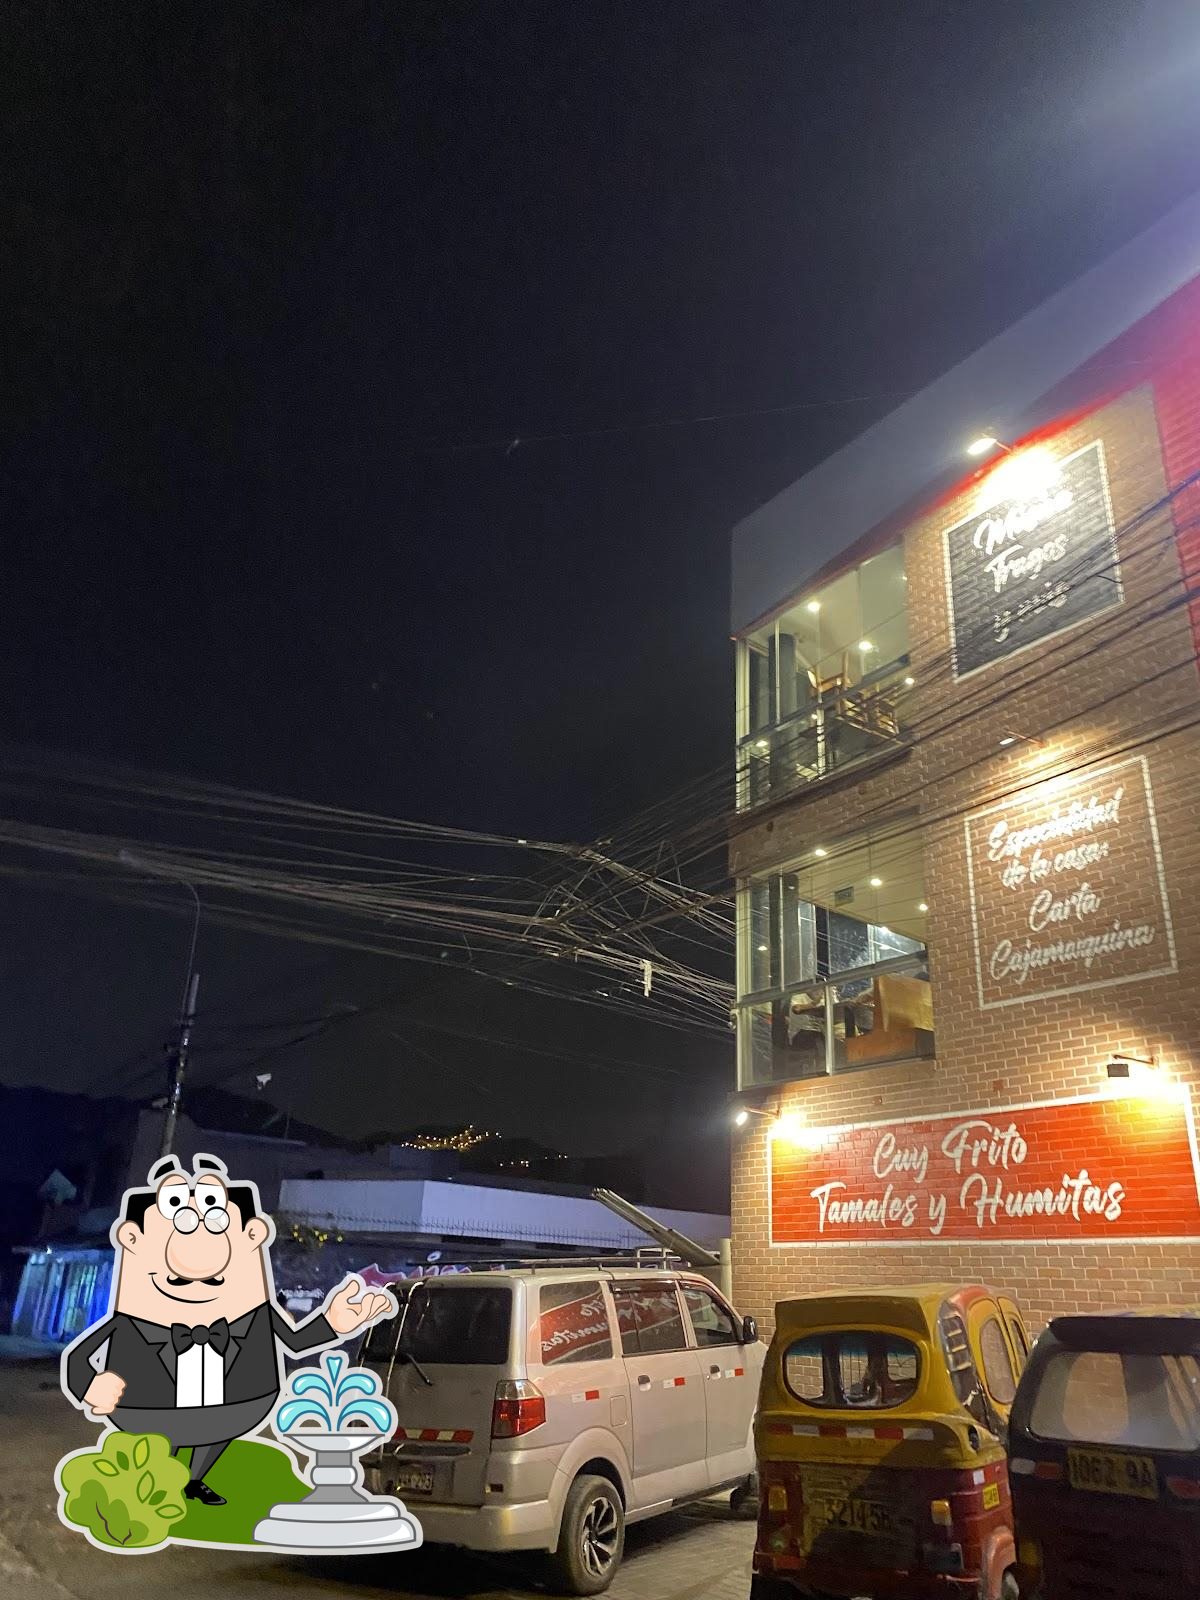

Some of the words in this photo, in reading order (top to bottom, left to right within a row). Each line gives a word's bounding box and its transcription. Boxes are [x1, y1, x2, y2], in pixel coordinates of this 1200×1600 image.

[1002, 859, 1029, 891] de
[1029, 849, 1052, 883] la
[1029, 882, 1101, 931] Carta
[990, 919, 1155, 984] Cajamarquina
[873, 1132, 928, 1183] Cuy
[942, 1120, 1028, 1174] Frito
[810, 1182, 917, 1232] Tamales
[929, 1193, 946, 1235] y
[960, 1169, 1126, 1227] Humitas
